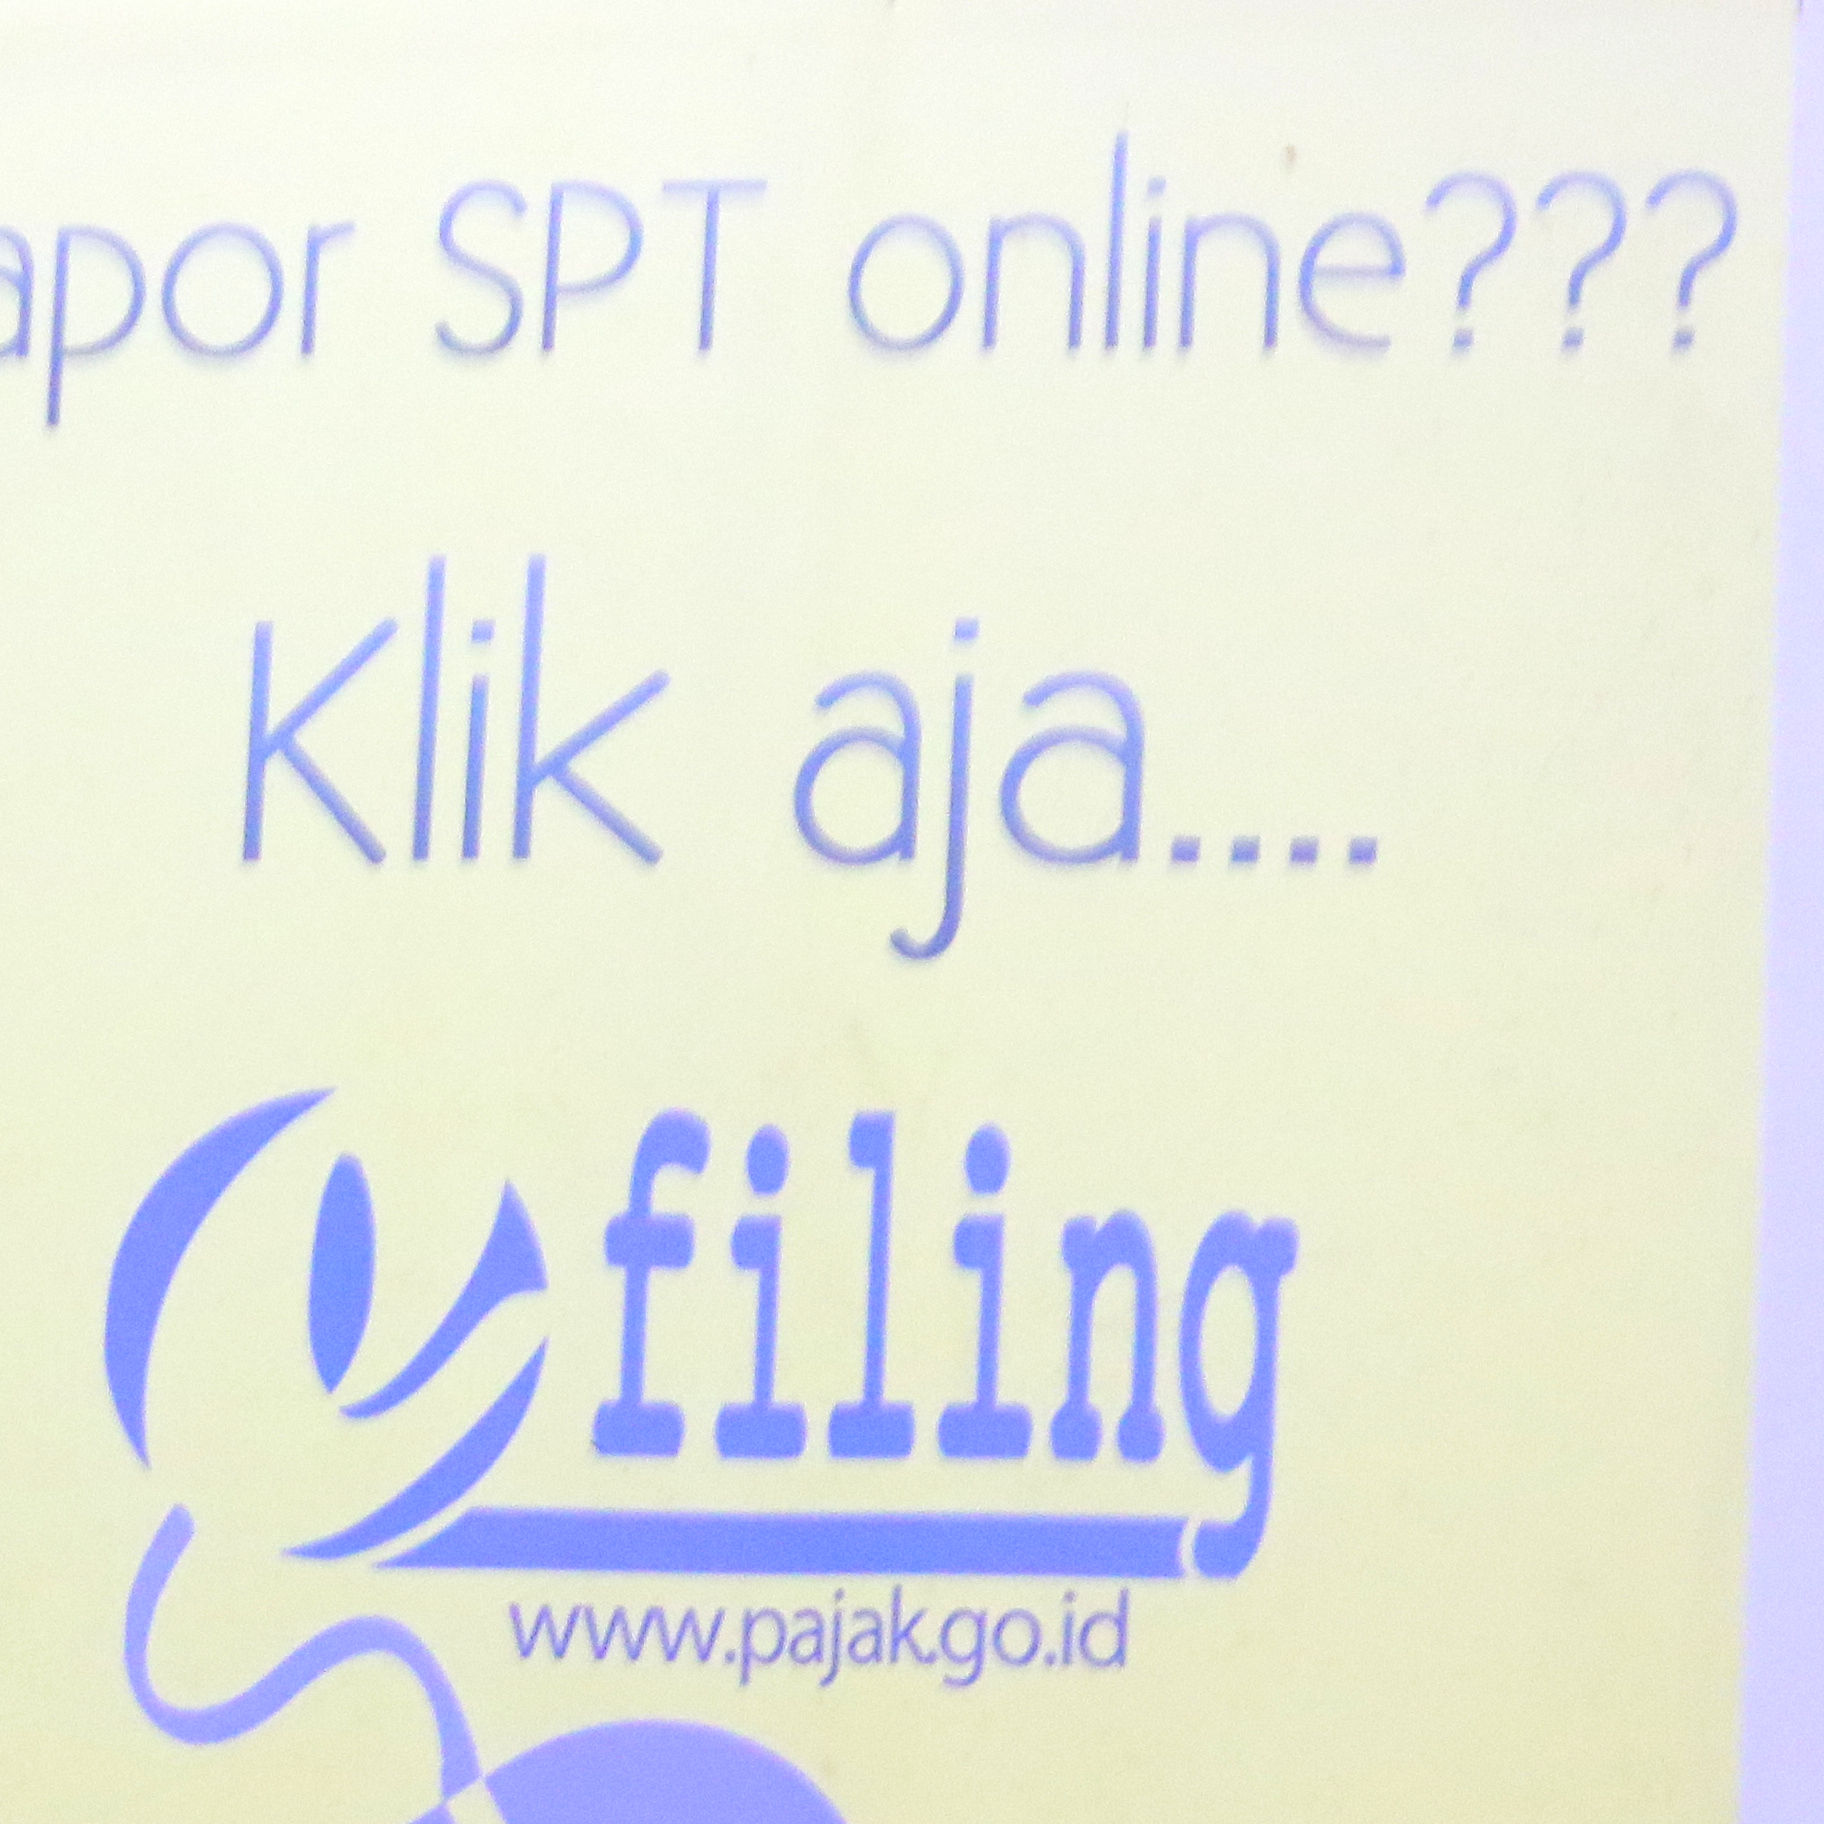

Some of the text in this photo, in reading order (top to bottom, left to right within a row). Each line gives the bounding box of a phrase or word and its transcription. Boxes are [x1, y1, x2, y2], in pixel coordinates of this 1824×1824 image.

[434, 178, 768, 355] SPT
[847, 129, 1740, 352] online???
[241, 553, 671, 866] Klik
[508, 1584, 1130, 1688] www.pajak.go.id
